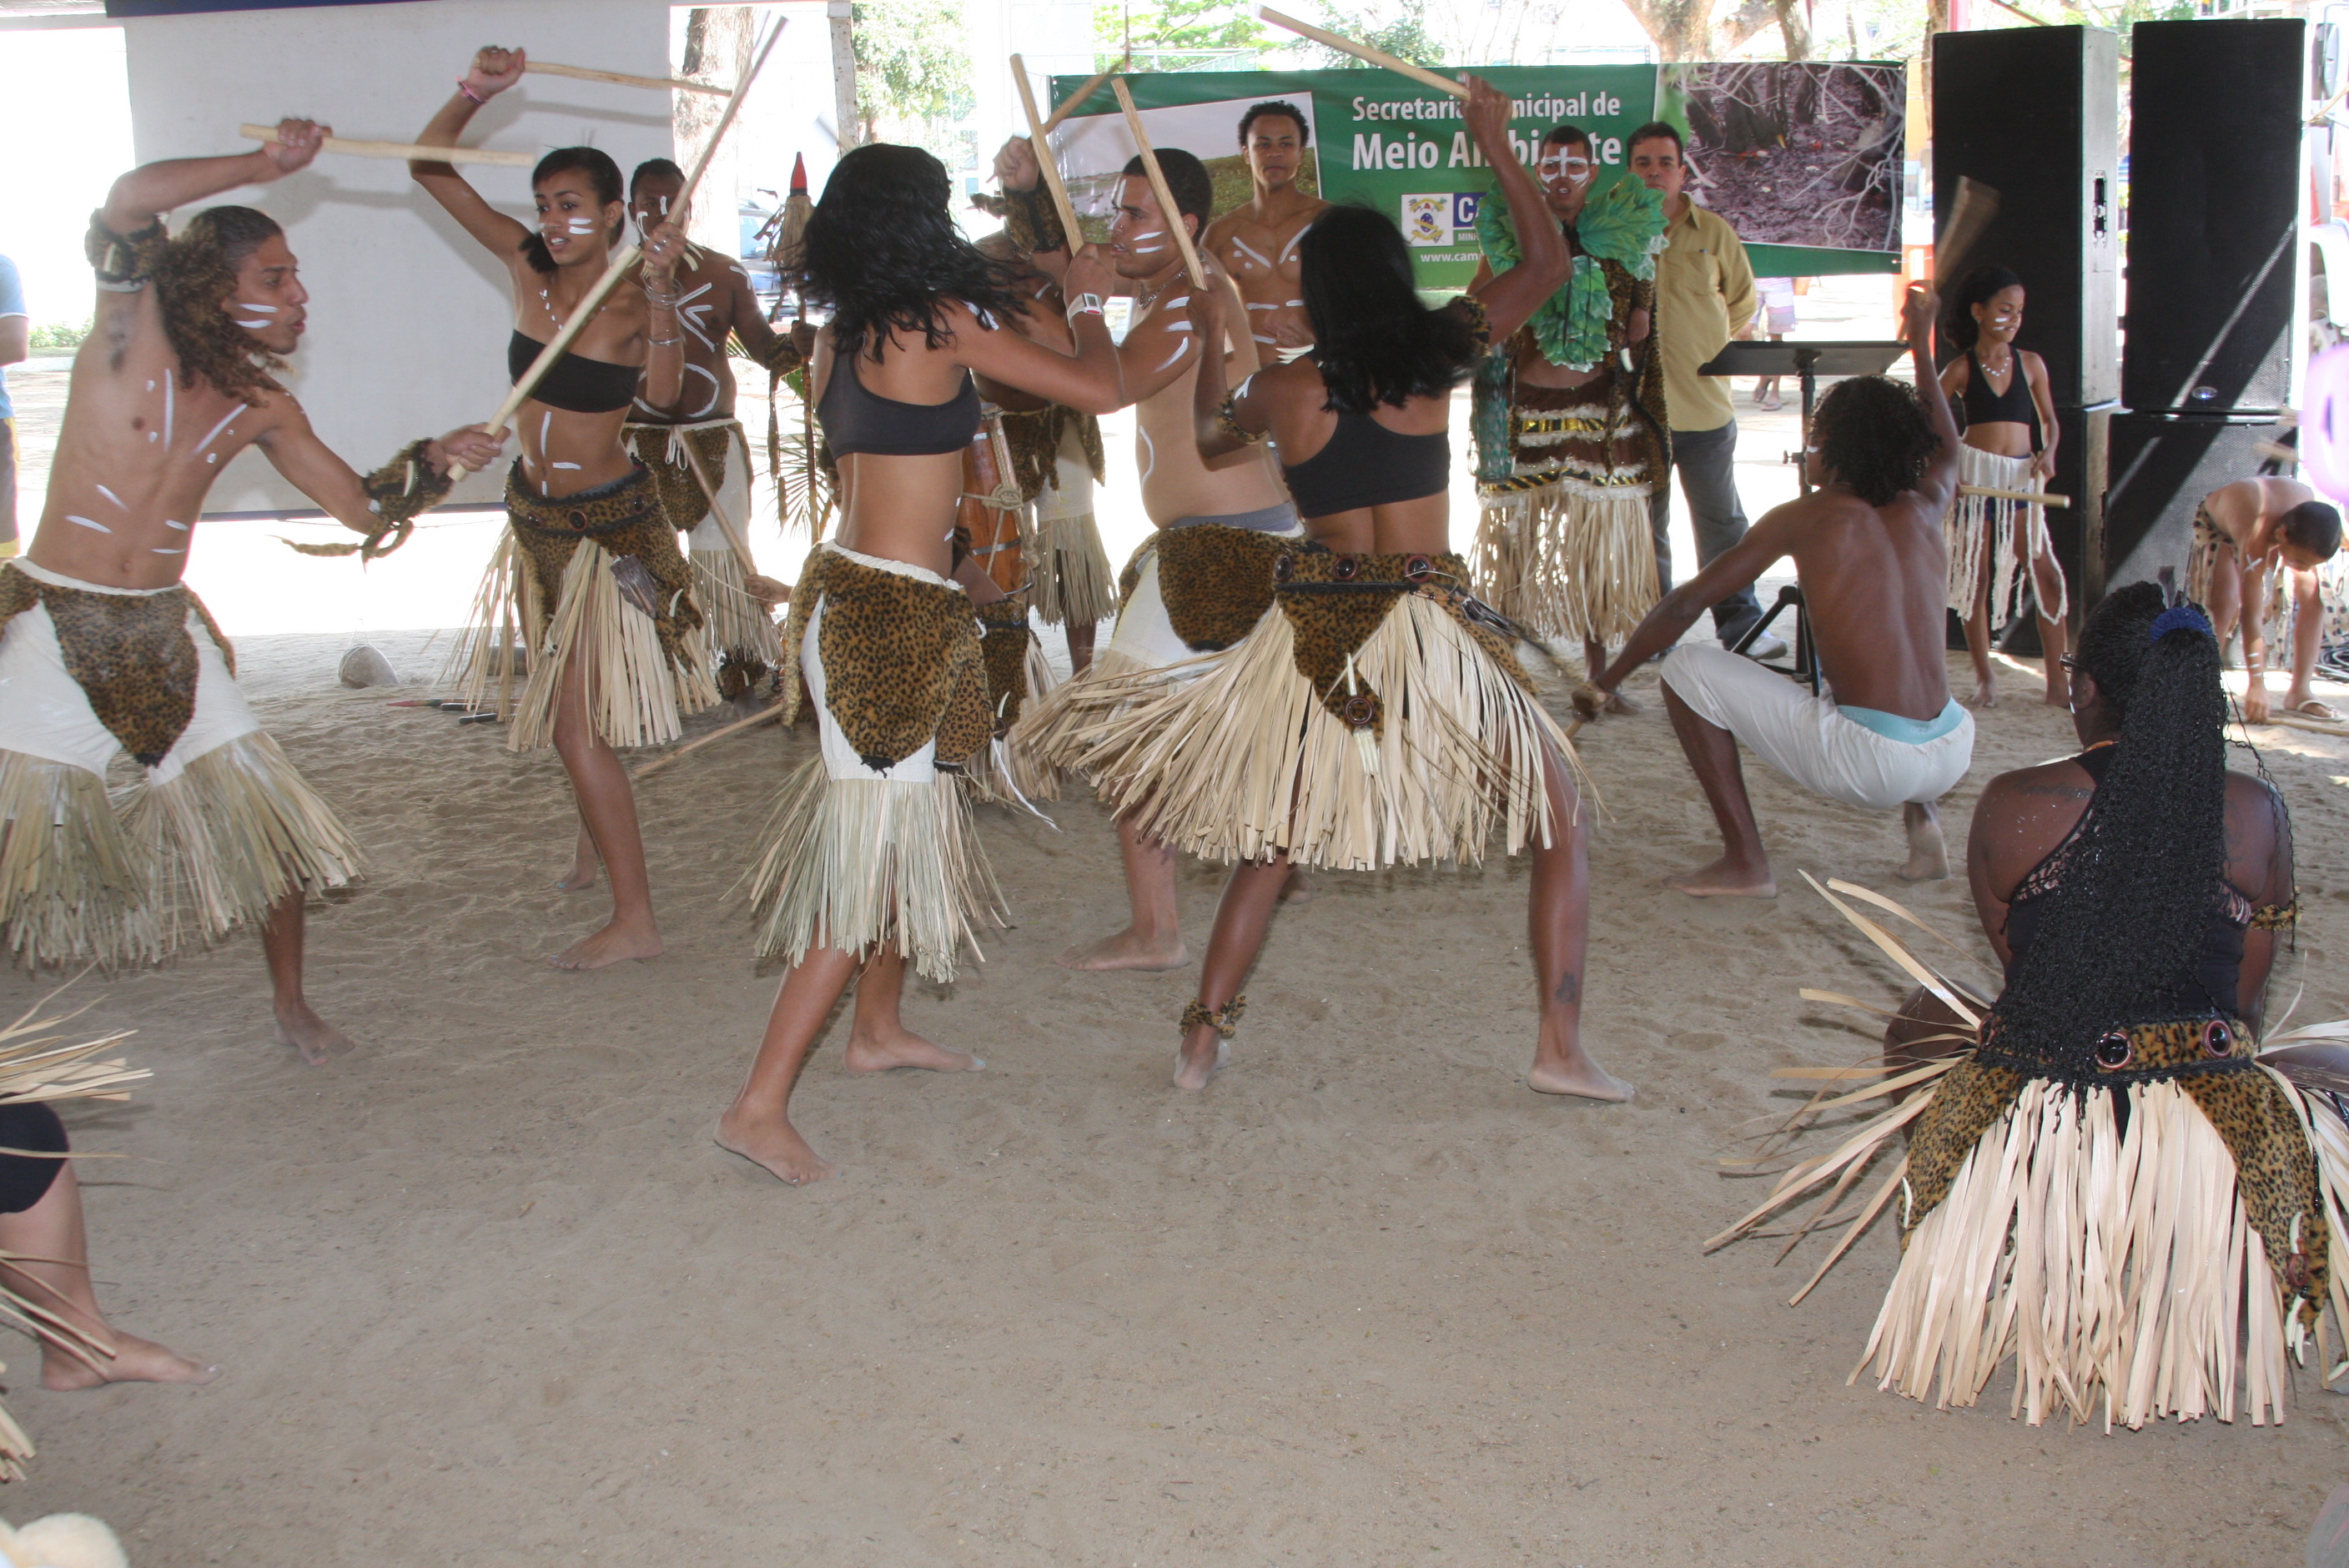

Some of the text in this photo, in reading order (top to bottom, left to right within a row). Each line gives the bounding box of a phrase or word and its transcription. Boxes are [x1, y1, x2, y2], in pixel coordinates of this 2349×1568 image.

[1512, 91, 1587, 123] nicipal
[1592, 90, 1621, 117] de
[1352, 128, 1622, 171] Meio Abite
[1420, 253, 1481, 263] www.cam
